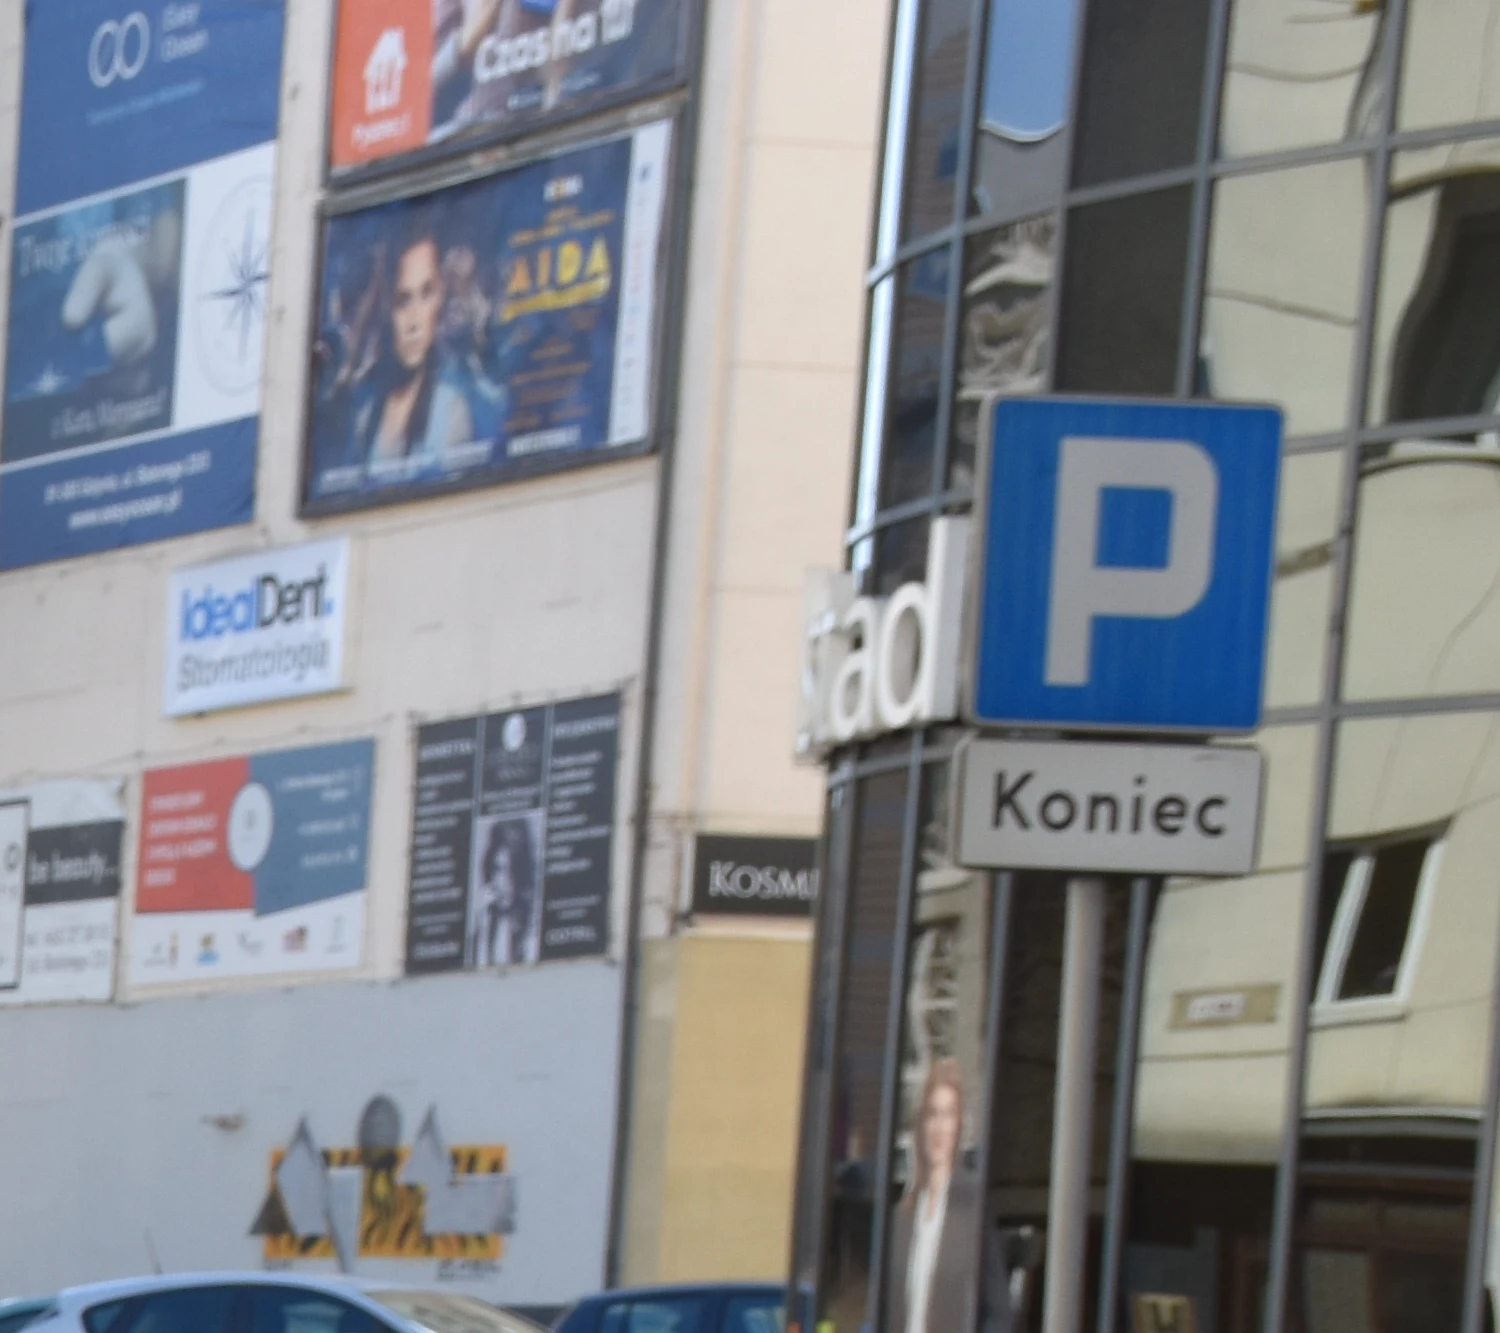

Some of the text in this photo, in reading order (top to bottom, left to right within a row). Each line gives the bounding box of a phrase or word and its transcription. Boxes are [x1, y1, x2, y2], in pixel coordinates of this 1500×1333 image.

[473, 13, 597, 83] Czas na
[1043, 436, 1220, 687] P
[990, 769, 1227, 837] Koniec
[708, 859, 819, 900] KOSM
